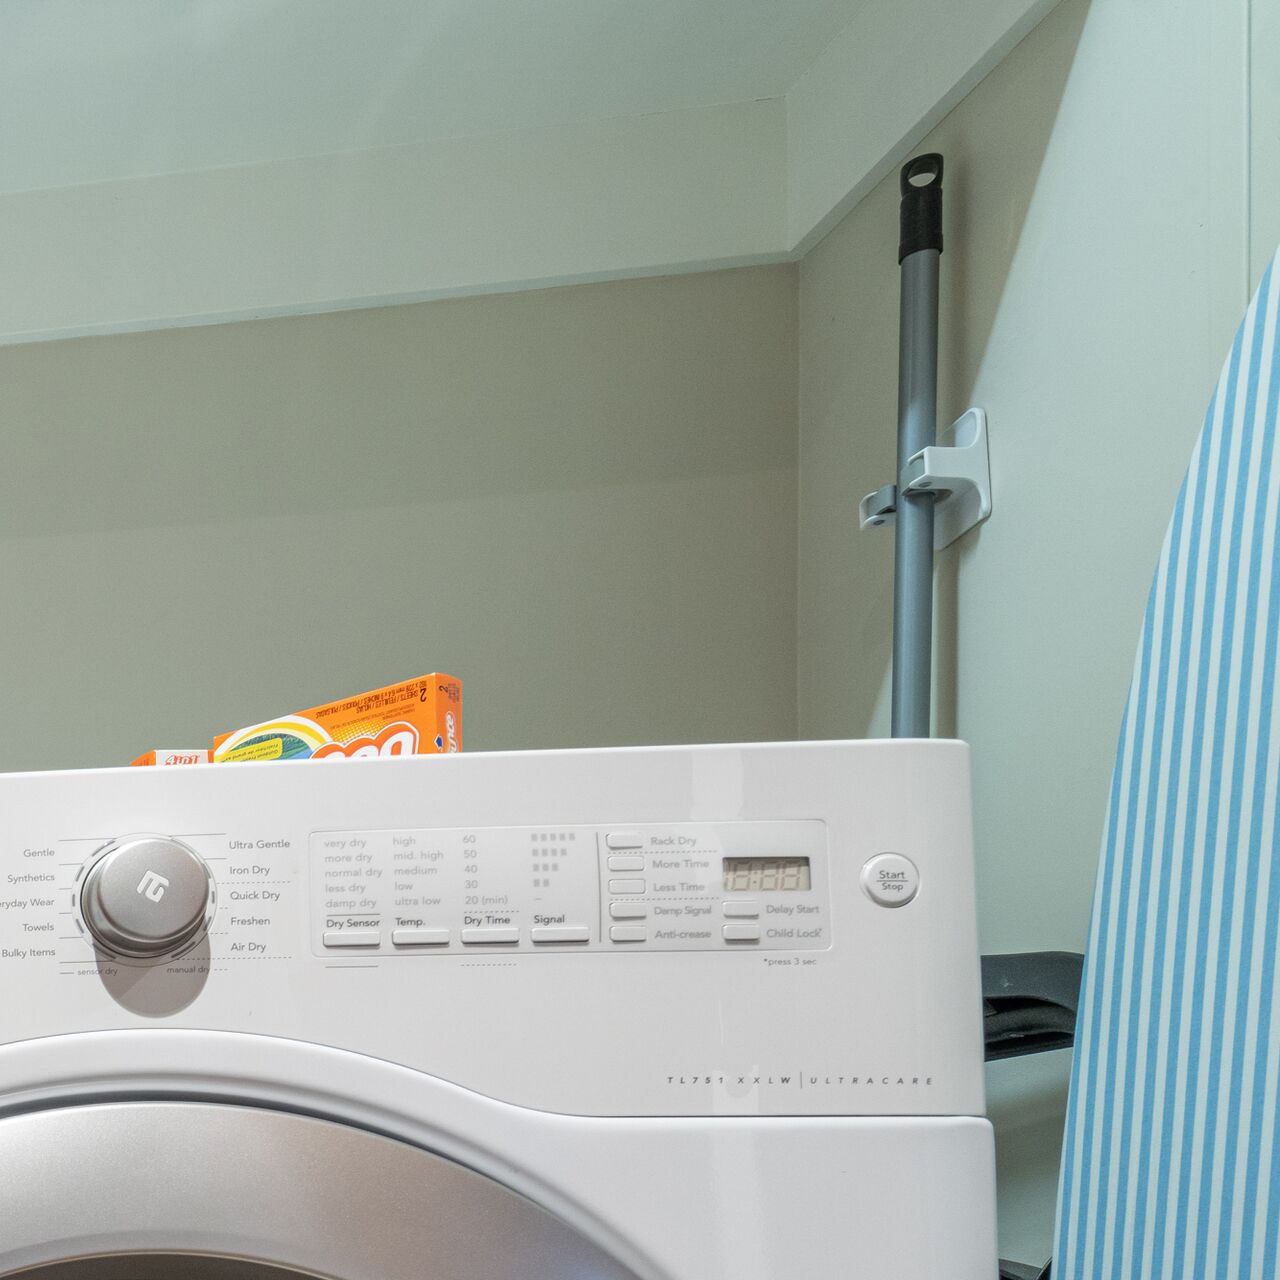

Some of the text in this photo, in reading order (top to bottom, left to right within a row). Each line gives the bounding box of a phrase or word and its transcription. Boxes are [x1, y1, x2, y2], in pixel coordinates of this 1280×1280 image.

[420, 688, 427, 703] 2
[228, 839, 291, 850] Ultra Gentle
[323, 838, 367, 849] very dry
[392, 836, 416, 847] high
[462, 834, 477, 844] 60
[650, 836, 697, 848] Rack Dry
[23, 848, 55, 858] Gentle
[324, 853, 373, 864] more dry
[419, 850, 444, 861] high
[463, 850, 477, 859] 50
[463, 865, 478, 874] 40
[652, 859, 710, 869] More Time
[229, 865, 271, 877] Iron Dry
[324, 867, 383, 879] normal dry
[393, 865, 438, 876] medium
[878, 869, 906, 880] Start
[7, 873, 55, 884] Synthetics
[325, 883, 366, 894] less dry
[394, 881, 414, 892] low
[464, 880, 479, 889] 30
[652, 882, 706, 892] Less Time
[881, 882, 904, 892] Stop
[229, 890, 281, 902] Quick Dry
[394, 896, 441, 906] ultra low
[465, 895, 509, 906] 20 (min)
[28, 897, 55, 908] Wear
[325, 898, 377, 910] damp dry
[654, 905, 712, 916] Damp Signal
[766, 904, 820, 915] Delay Start
[230, 916, 271, 926] Freshen
[326, 918, 381, 930] Dry Sensor
[395, 917, 426, 928] Temp.
[463, 915, 511, 926] Dry Time
[533, 914, 565, 925] Signal
[22, 922, 55, 933] Towels
[654, 929, 712, 939] Anti-crease
[766, 928, 794, 939] Child
[1, 947, 56, 960] Bulky Items
[230, 942, 267, 954] Air Dry
[794, 957, 800, 966] 3
[802, 958, 817, 966] sec
[77, 967, 118, 977] sensor dry
[166, 965, 211, 976] manual dry
